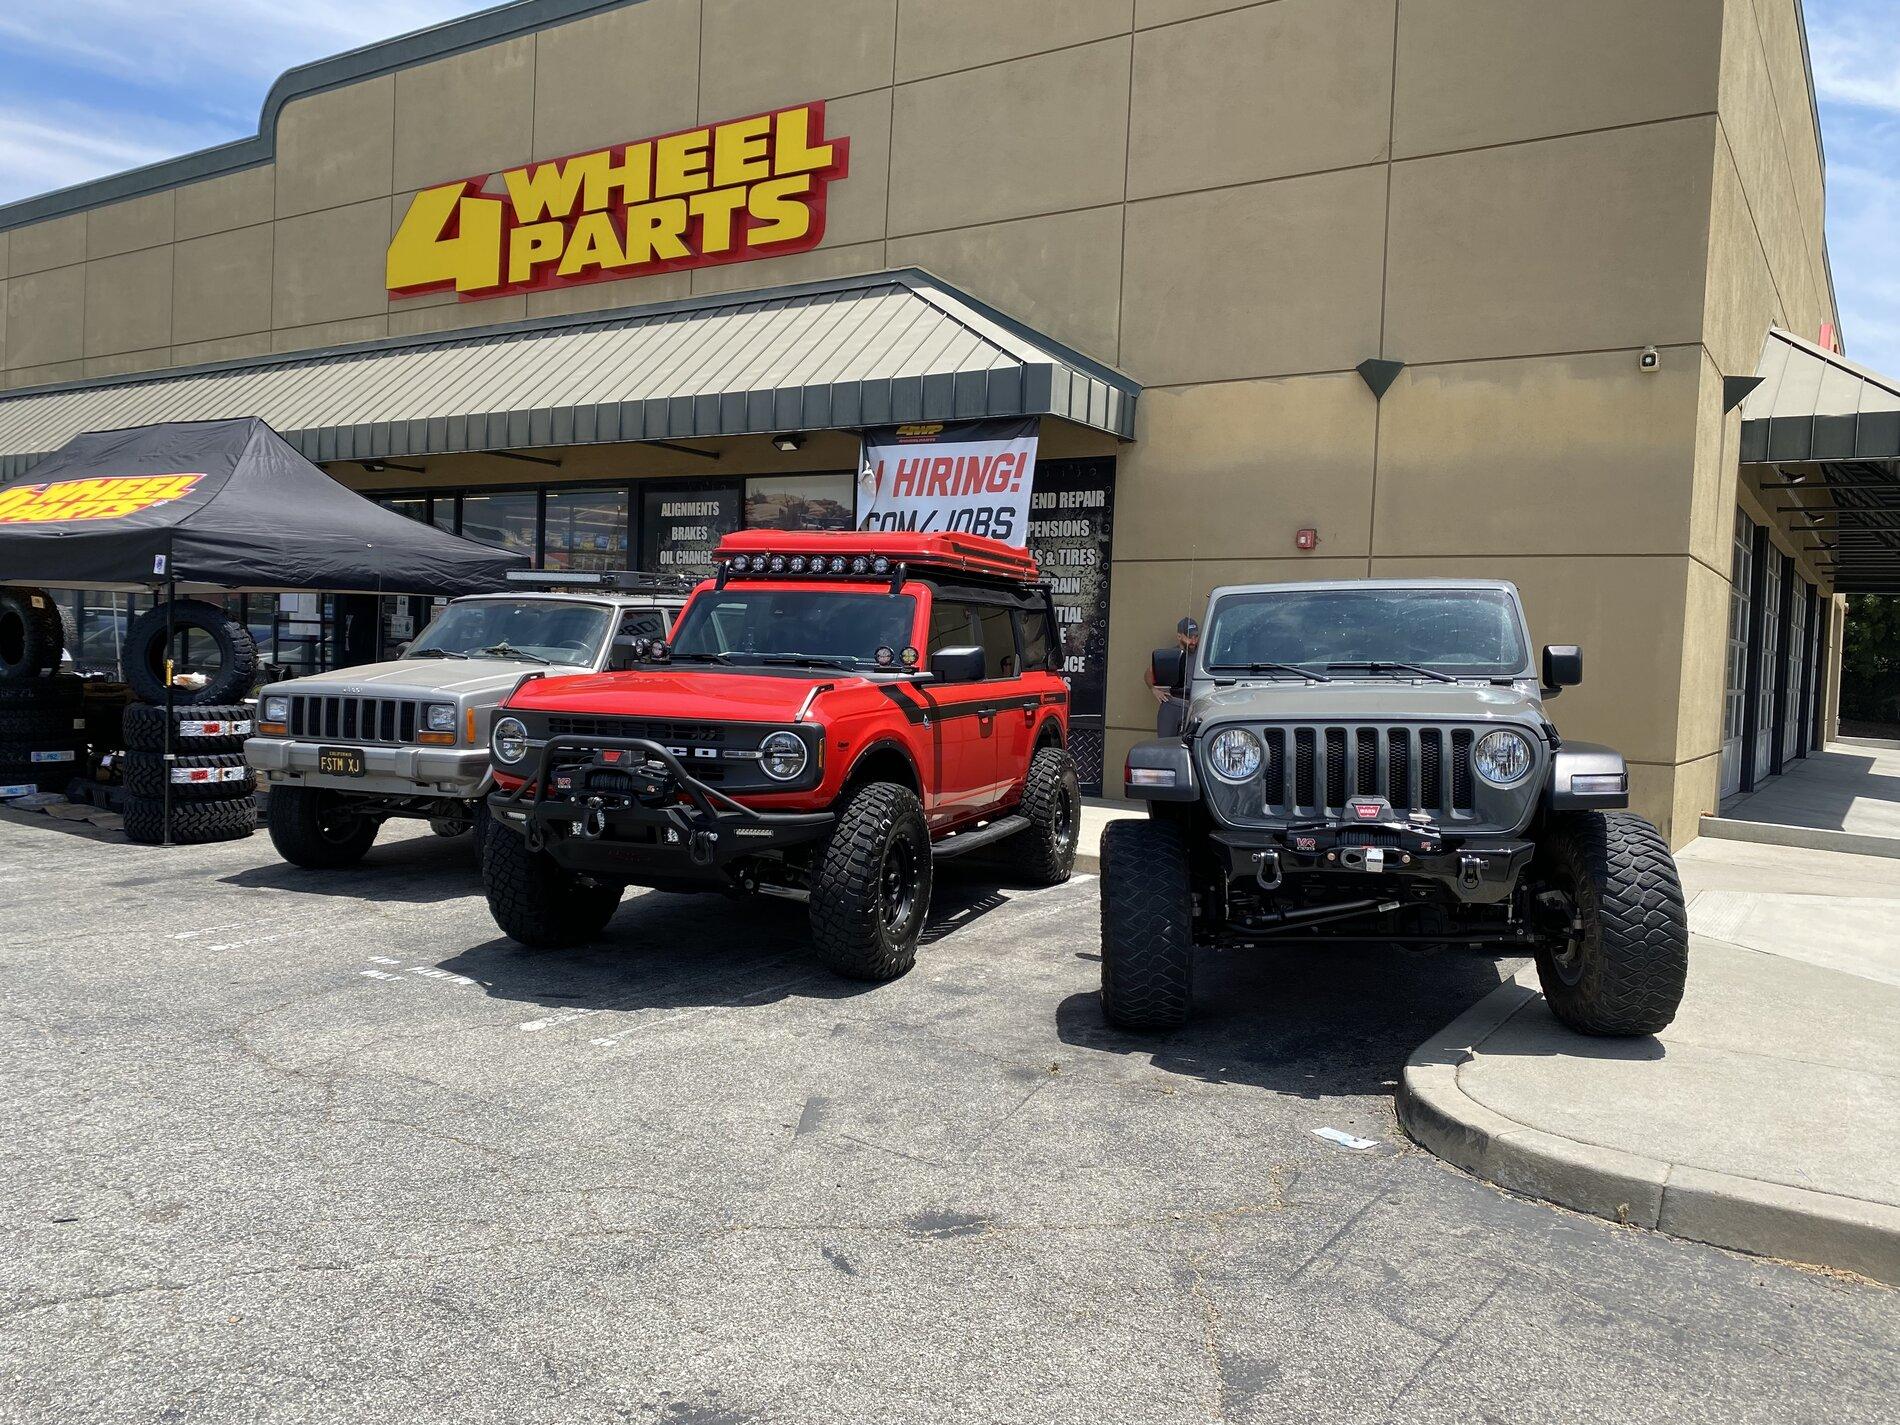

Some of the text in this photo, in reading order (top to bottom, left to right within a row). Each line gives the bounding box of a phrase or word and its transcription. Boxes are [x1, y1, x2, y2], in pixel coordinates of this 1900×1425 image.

[386, 107, 833, 292] 4 WHEEL
[508, 174, 810, 283] PARTS
[892, 452, 1028, 498] HIRING!
[32, 475, 200, 504] WHEEL
[1, 498, 154, 522] PARTS
[661, 501, 720, 517] ALIGNMENTS
[1032, 490, 1105, 510] END REPAIR
[671, 526, 708, 541] BRAKES
[660, 551, 718, 565] OIL CHANGE
[1046, 552, 1056, 566] &
[1058, 548, 1096, 566] TIRES
[348, 758, 360, 773] XJ
